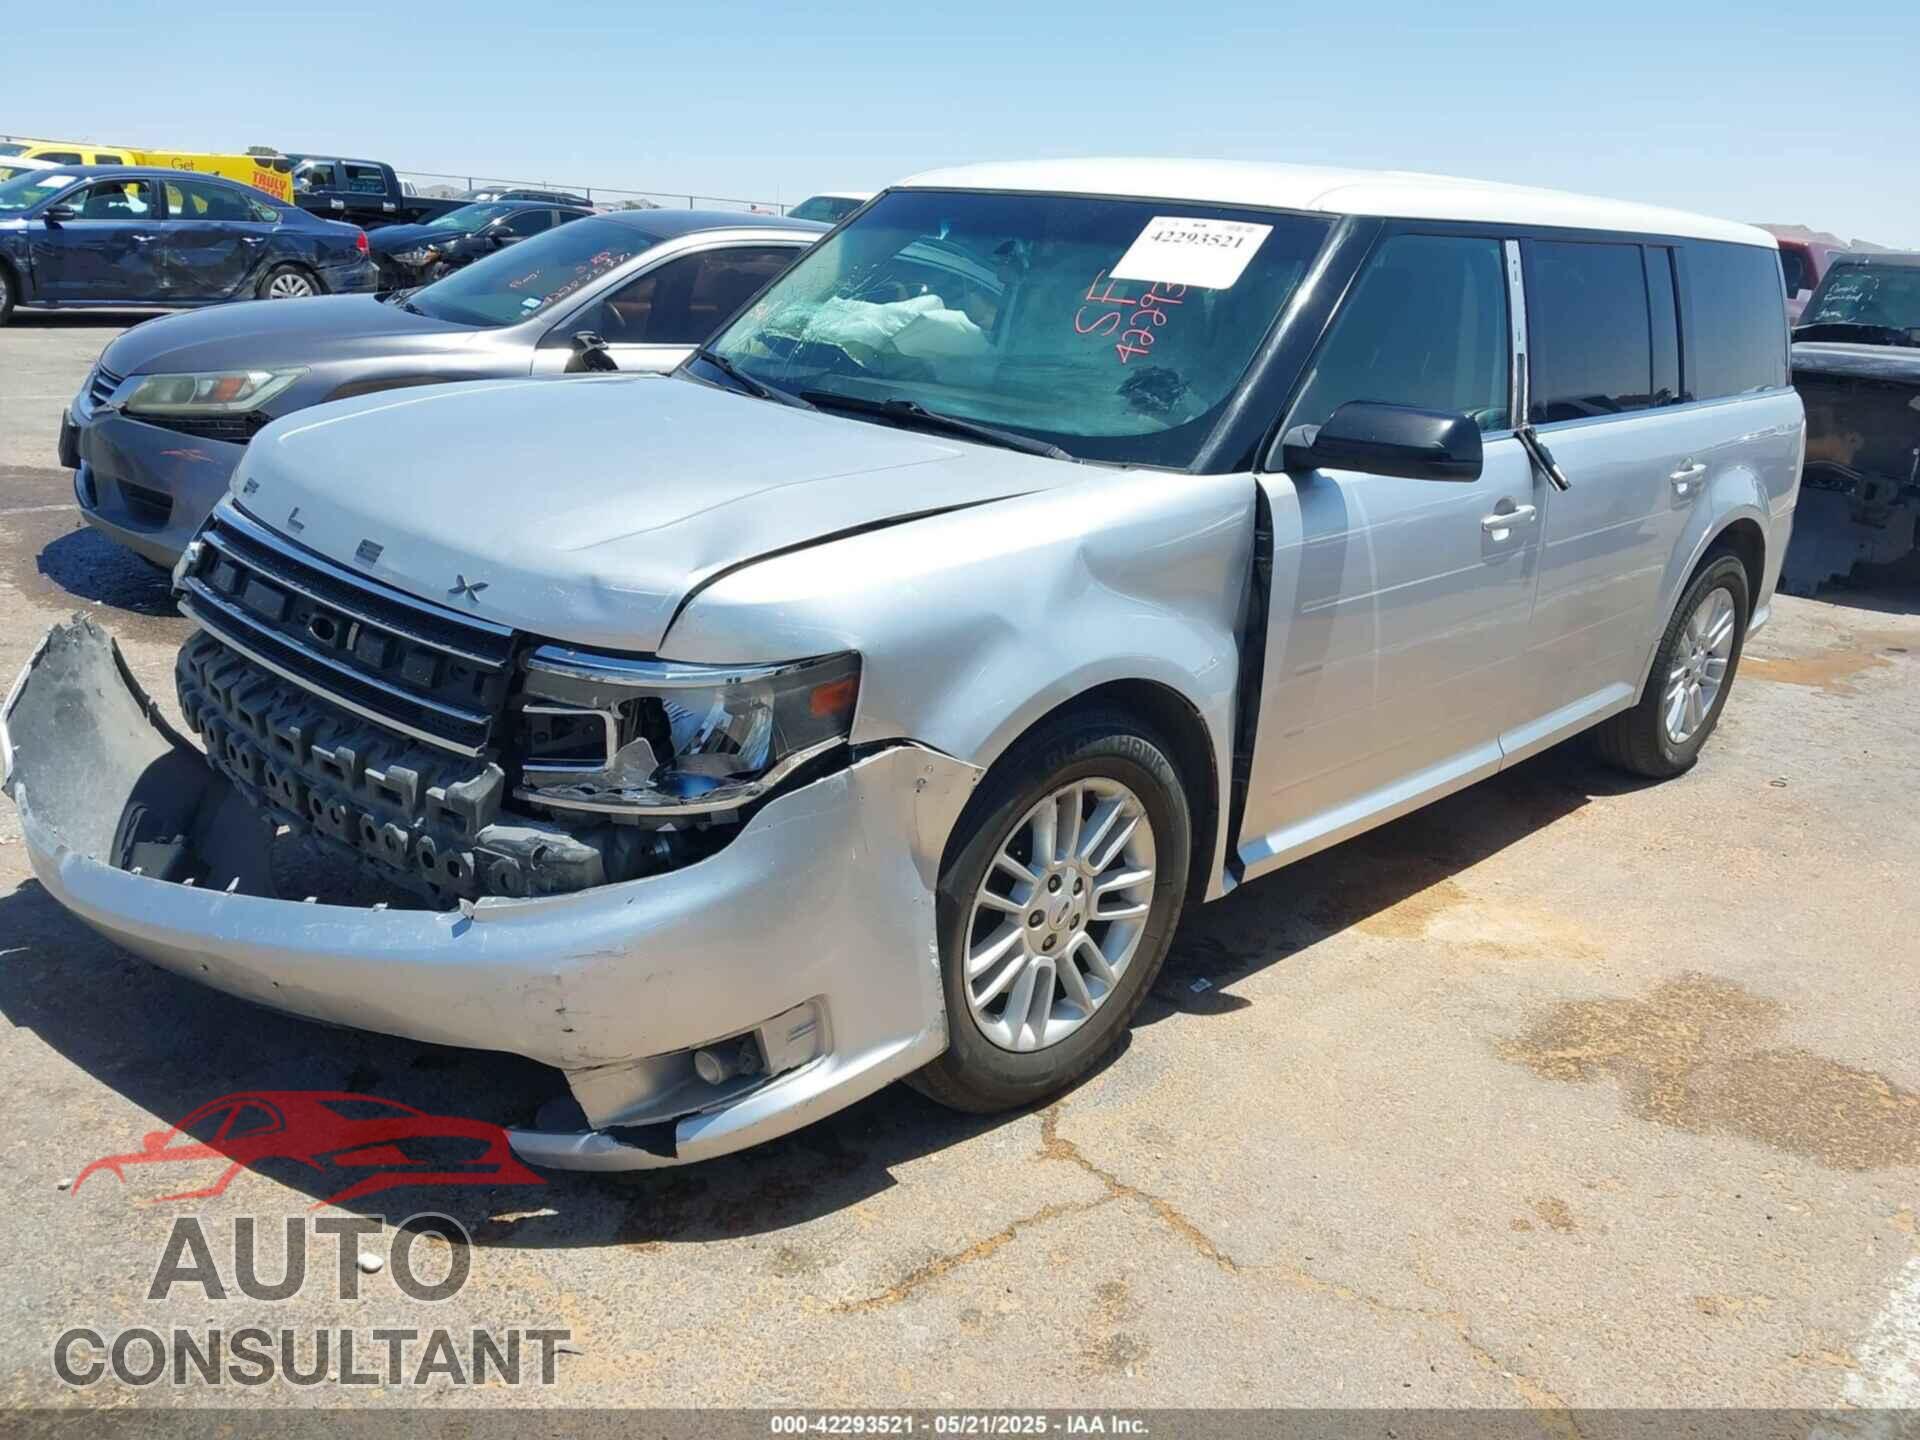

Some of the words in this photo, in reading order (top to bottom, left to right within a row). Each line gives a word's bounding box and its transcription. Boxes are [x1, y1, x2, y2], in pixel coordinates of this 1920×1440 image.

[171, 157, 195, 171] Get
[252, 171, 288, 191] TRULY
[1151, 230, 1245, 249] 42293521
[243, 477, 490, 605] FLEX
